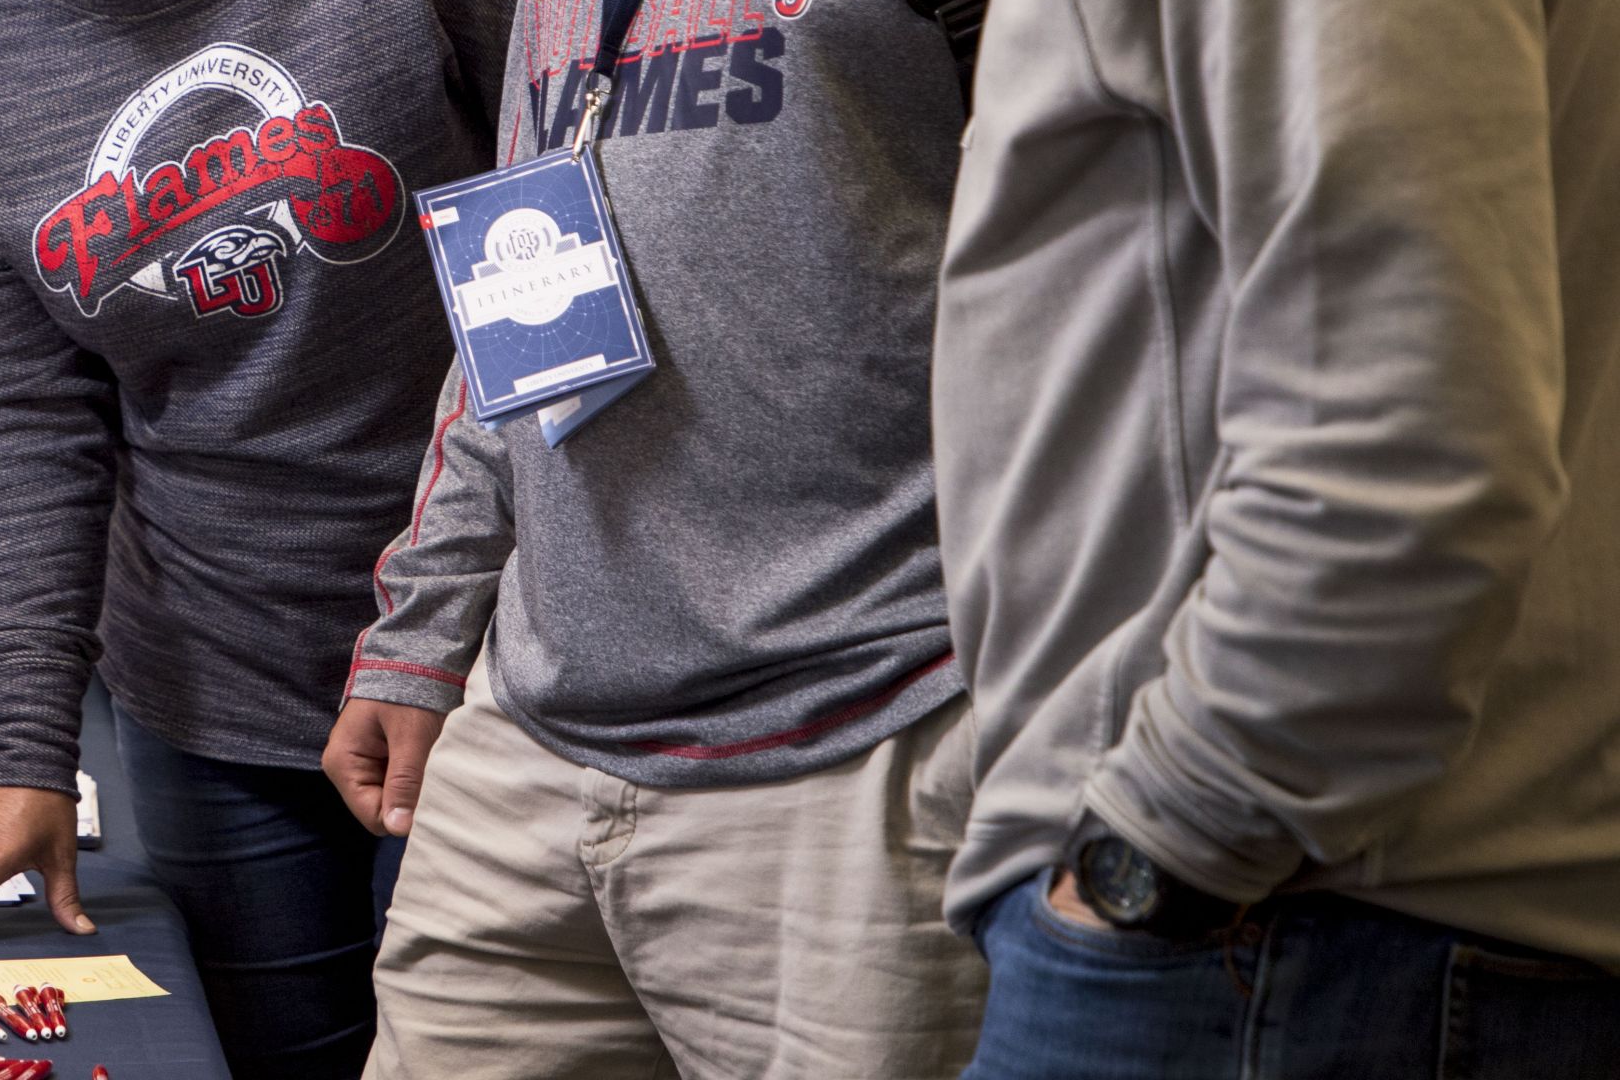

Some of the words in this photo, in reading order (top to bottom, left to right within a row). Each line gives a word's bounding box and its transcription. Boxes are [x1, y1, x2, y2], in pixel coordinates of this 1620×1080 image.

[105, 80, 171, 163] LIBERTY
[177, 56, 290, 109] UNIVERSITY
[37, 105, 337, 298] Flames
[180, 252, 282, 317] LU
[476, 262, 595, 309] ITINERARY
